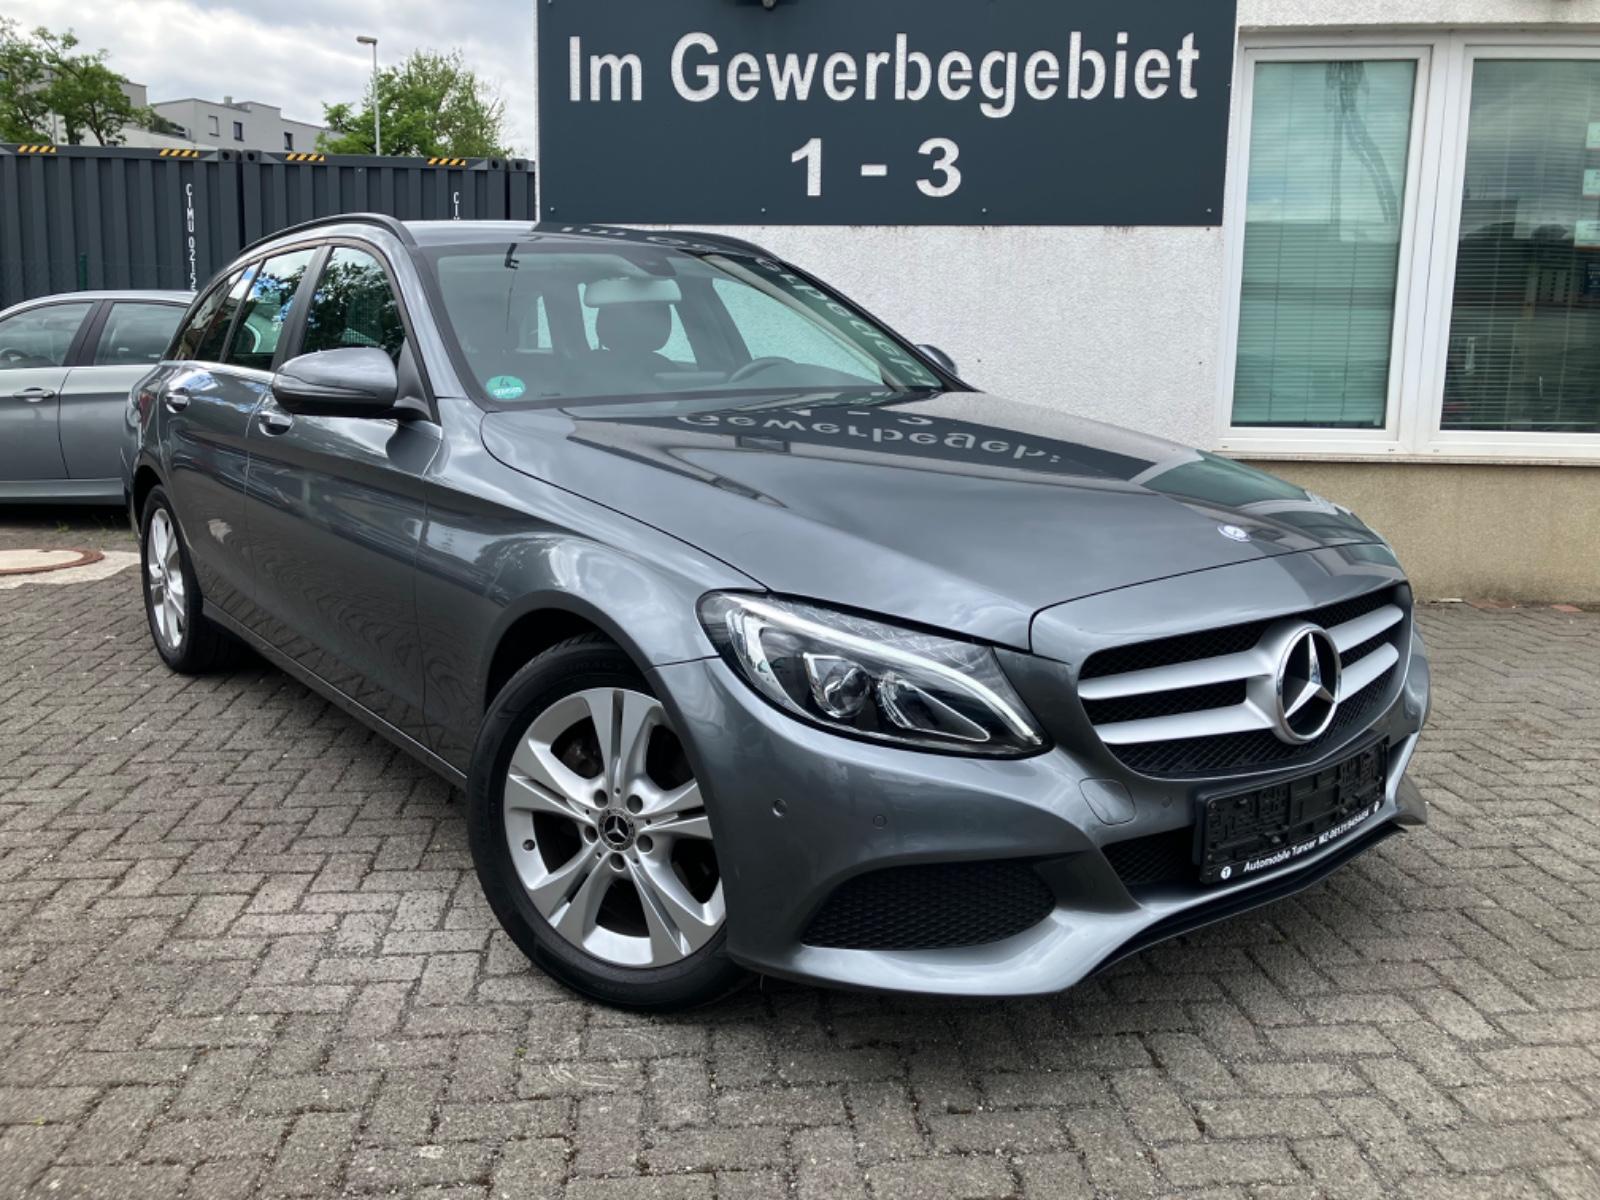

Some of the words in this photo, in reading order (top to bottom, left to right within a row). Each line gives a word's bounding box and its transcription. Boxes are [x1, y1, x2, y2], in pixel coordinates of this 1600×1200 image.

[569, 36, 642, 102] Im
[670, 31, 1201, 119] Gewerbegebiet
[791, 138, 822, 197] 1
[860, 164, 887, 177] -
[916, 137, 962, 198] 3
[453, 191, 461, 220] CI
[1243, 850, 1291, 873] Automobile
